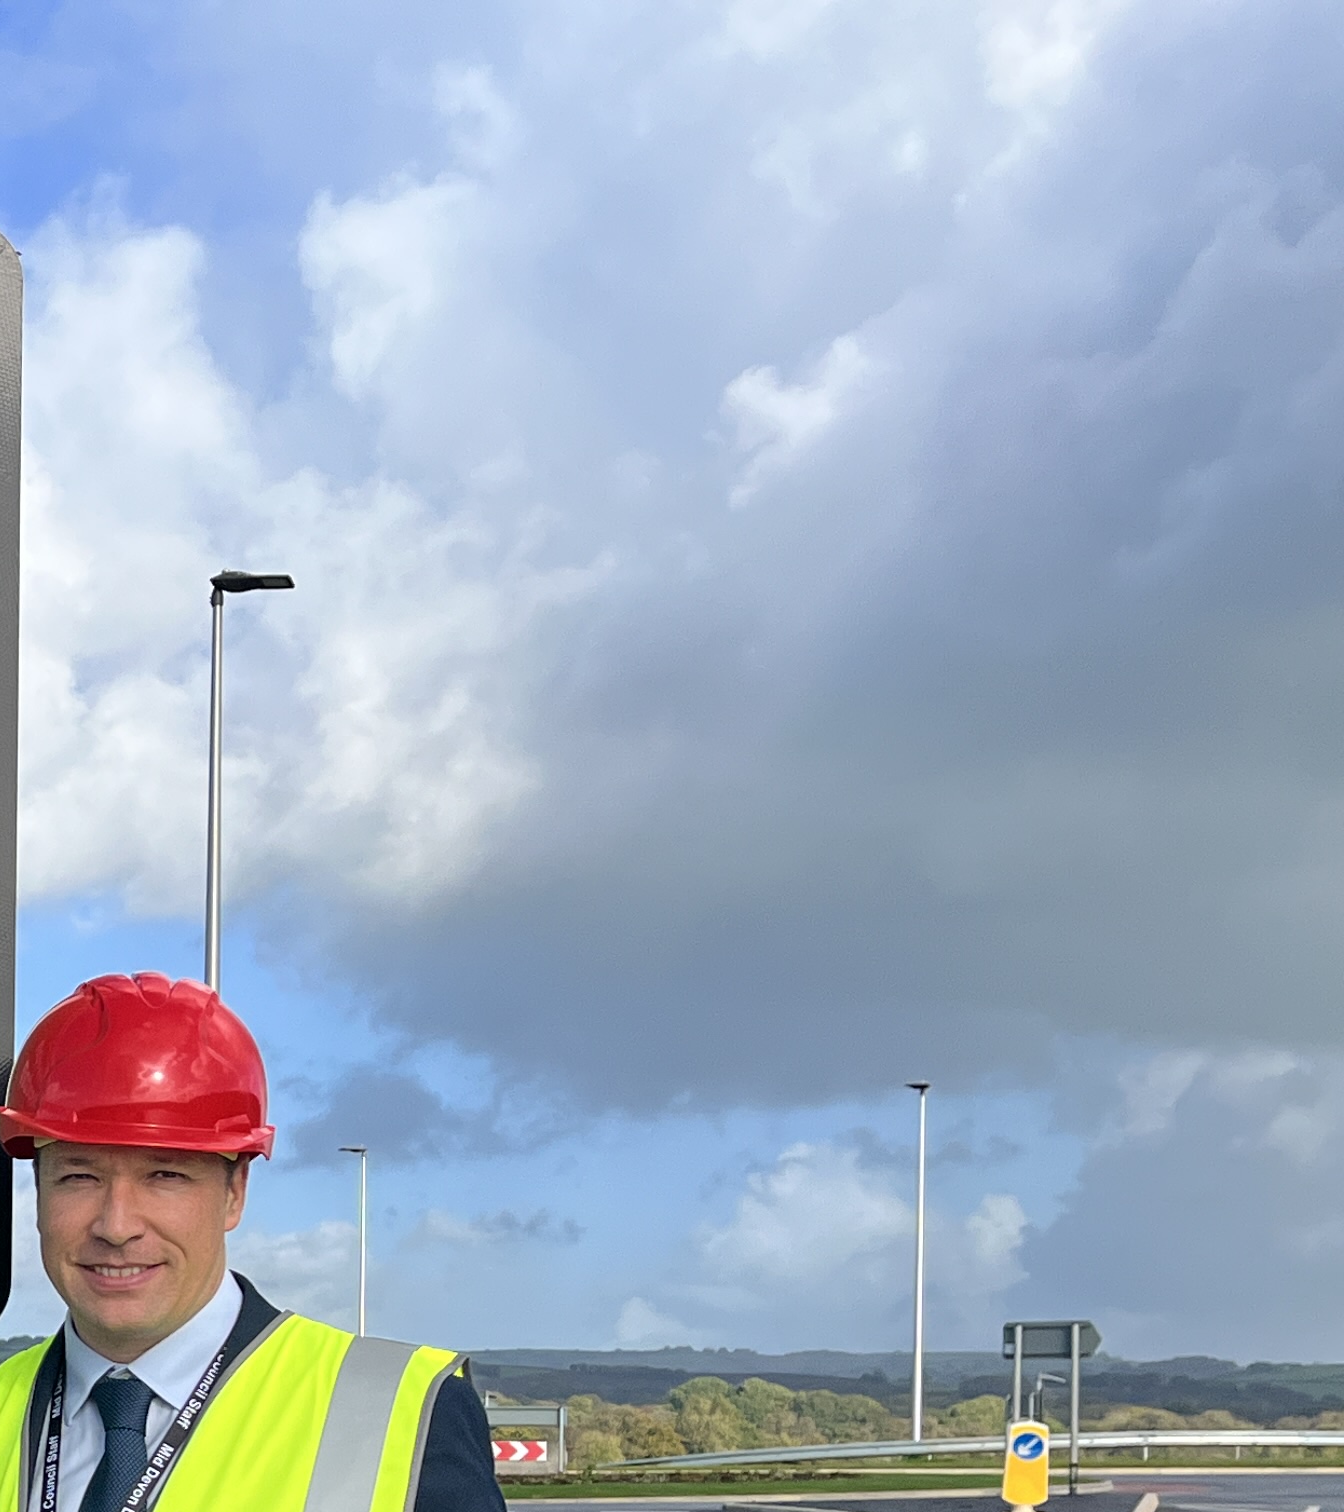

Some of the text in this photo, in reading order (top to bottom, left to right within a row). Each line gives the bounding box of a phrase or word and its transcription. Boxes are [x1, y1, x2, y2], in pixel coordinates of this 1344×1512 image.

[176, 1398, 202, 1430] Staff
[46, 1435, 59, 1463] Staff
[152, 1442, 175, 1469] Mid
[43, 1464, 57, 1510] Council
[127, 1466, 161, 1506] Devon
